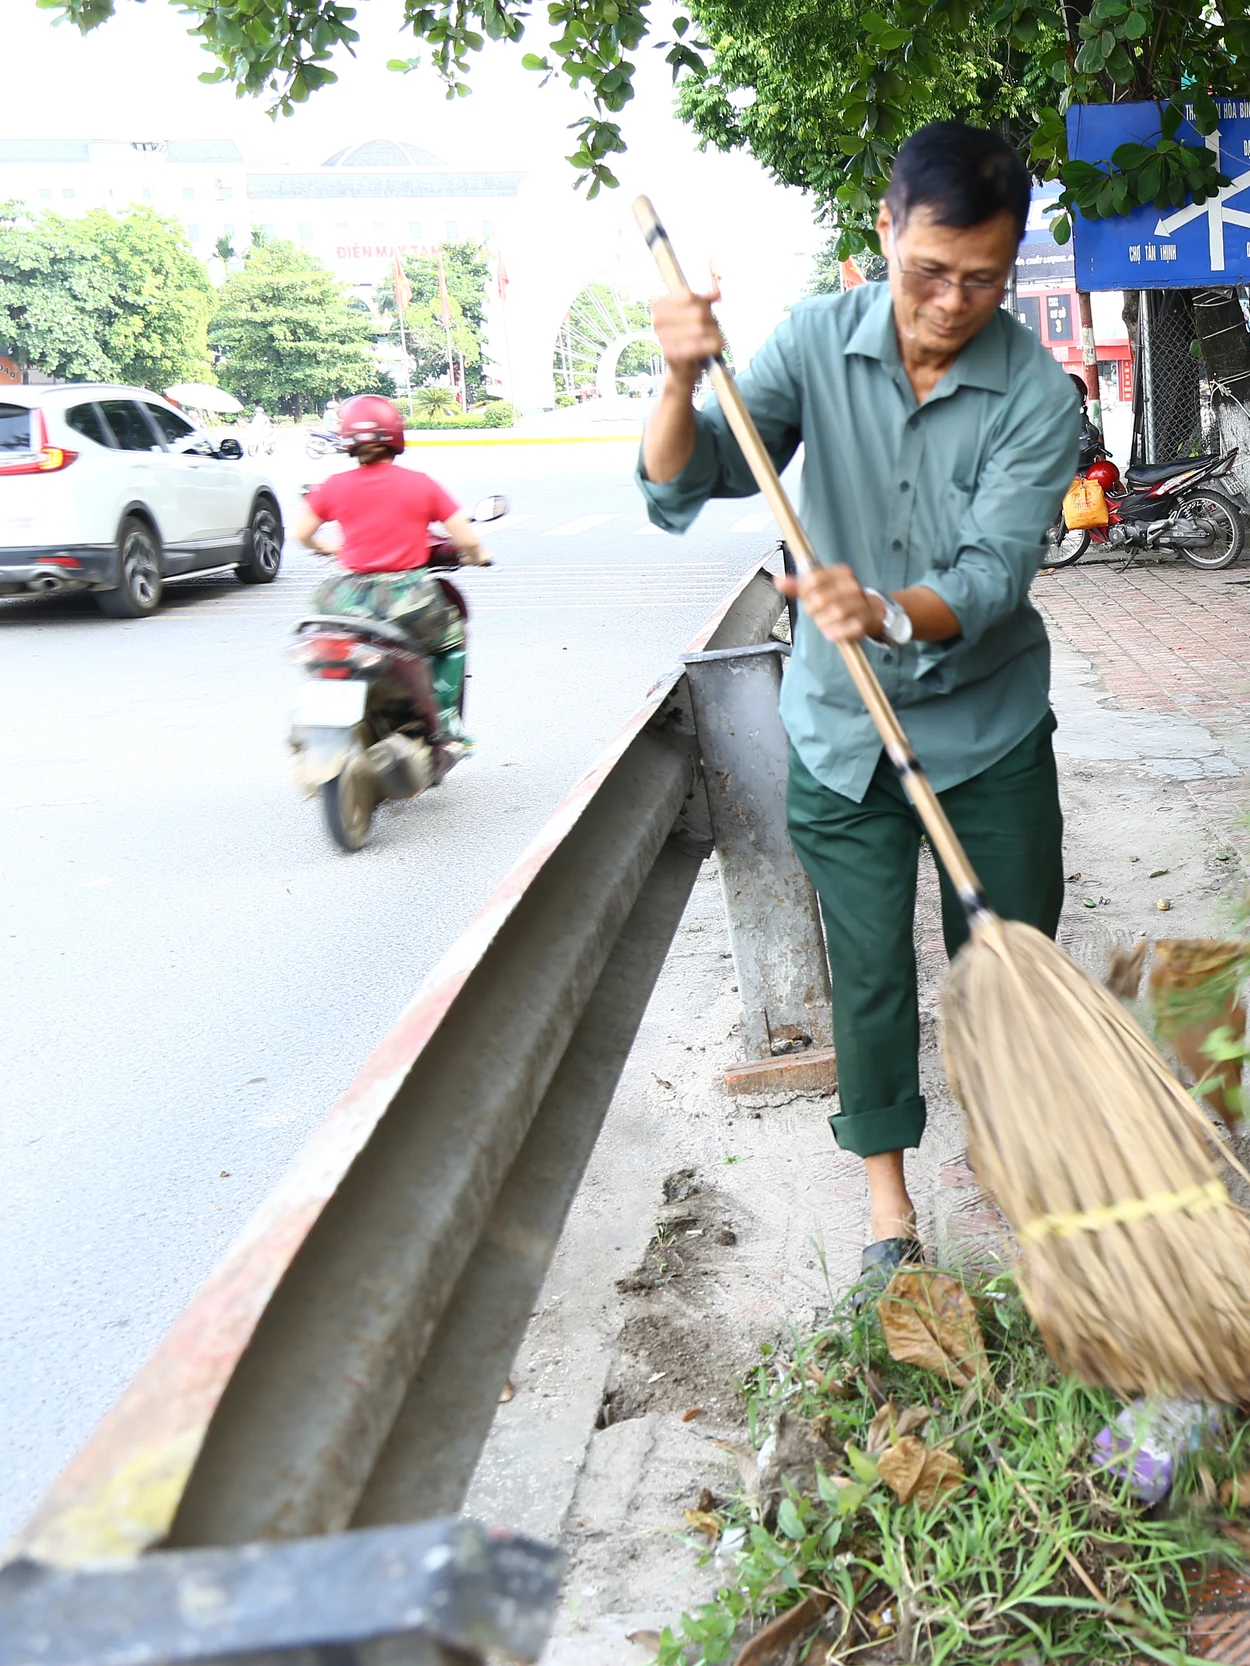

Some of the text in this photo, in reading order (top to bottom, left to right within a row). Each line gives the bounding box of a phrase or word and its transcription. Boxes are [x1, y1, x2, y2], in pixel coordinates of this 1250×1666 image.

[1223, 99, 1237, 119] HÒA
[1129, 241, 1177, 265] CHỢ TÂN THỊNH
